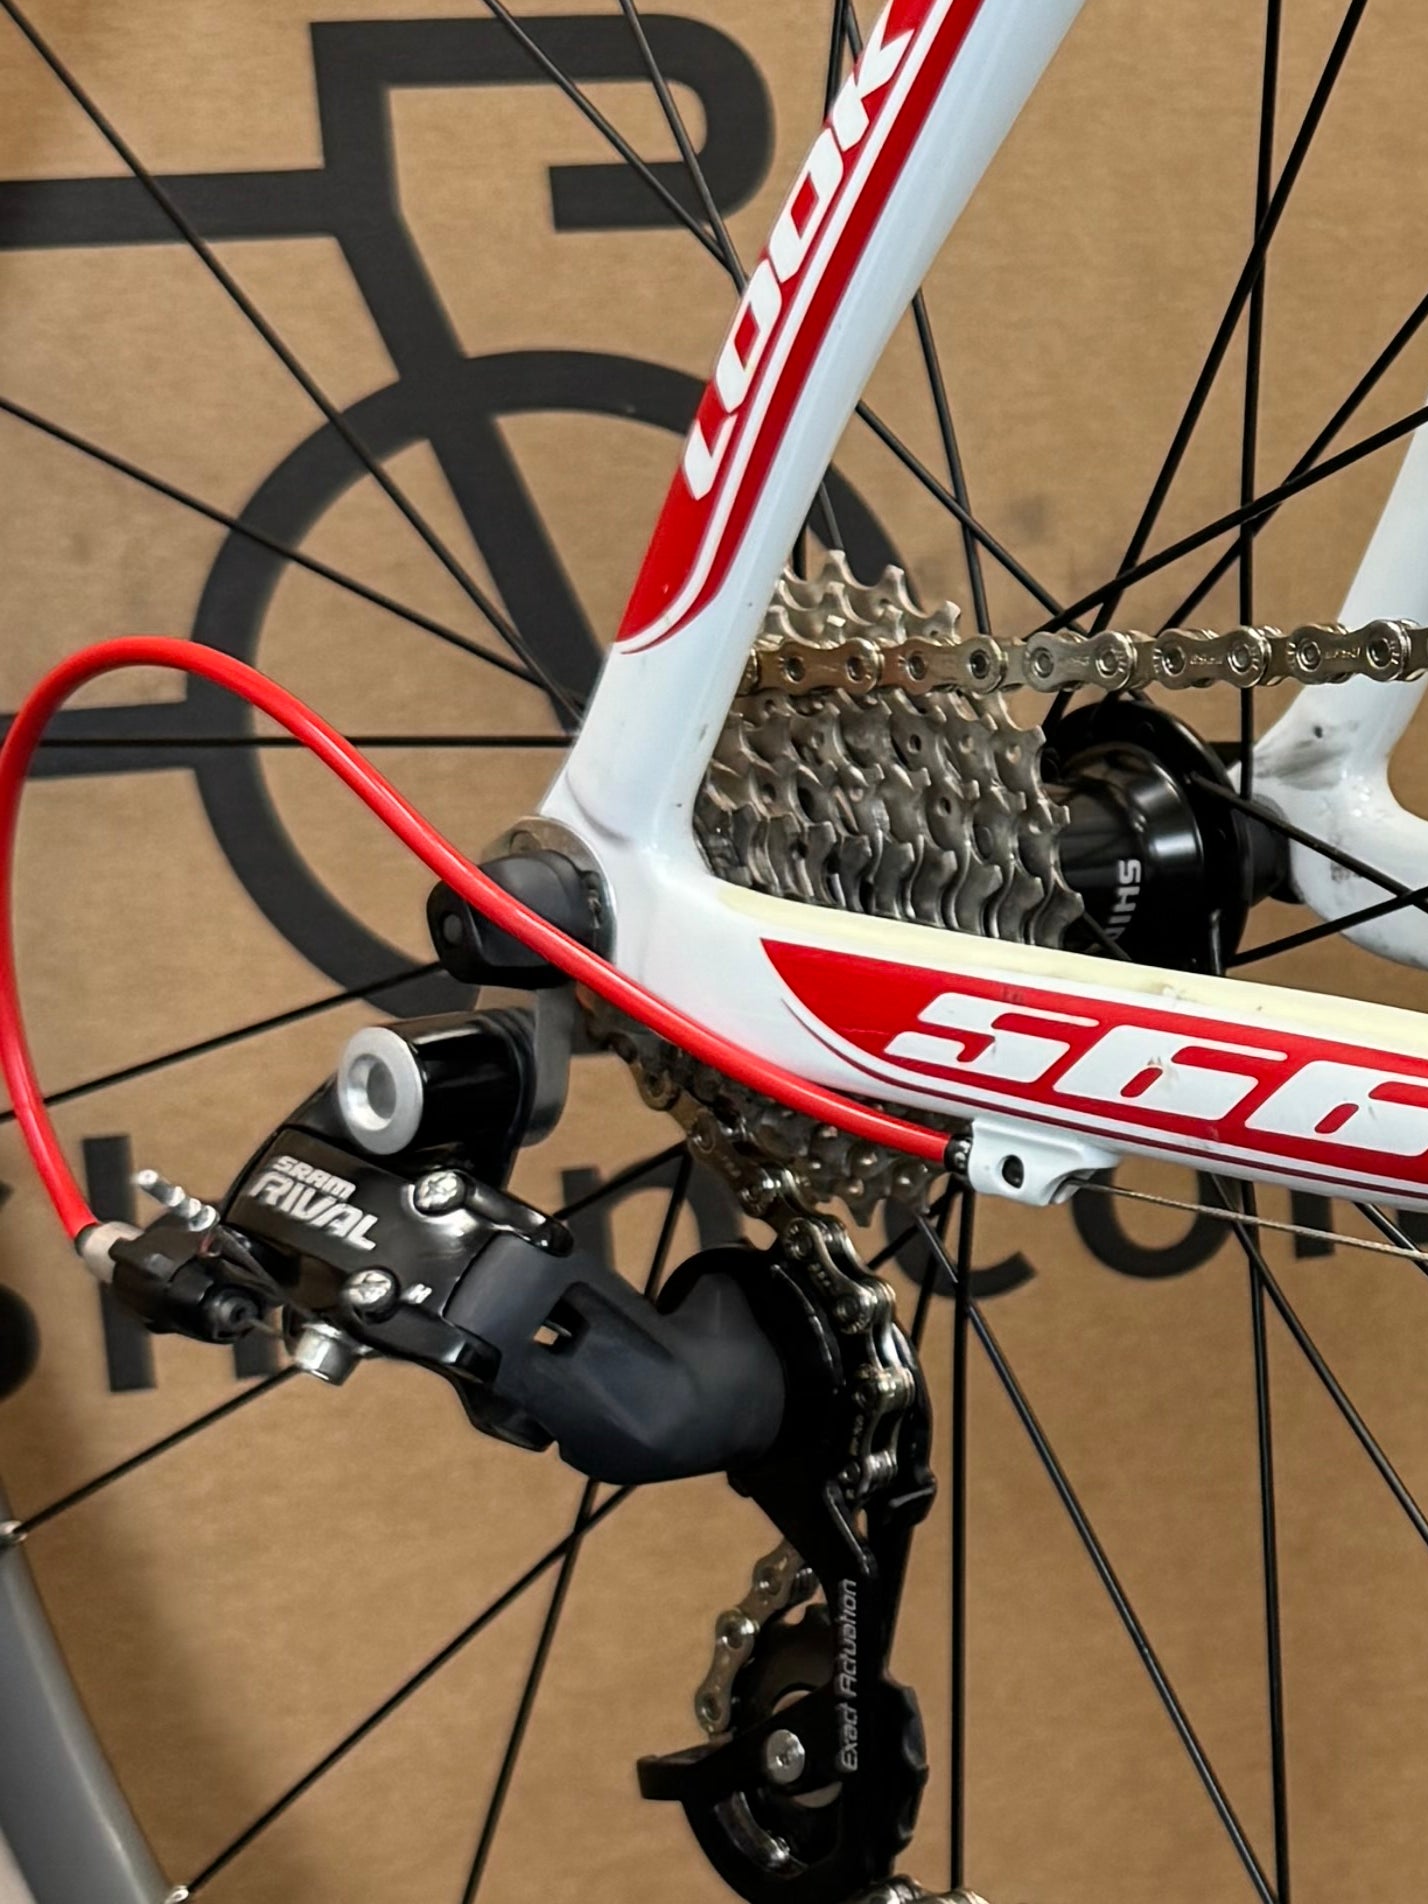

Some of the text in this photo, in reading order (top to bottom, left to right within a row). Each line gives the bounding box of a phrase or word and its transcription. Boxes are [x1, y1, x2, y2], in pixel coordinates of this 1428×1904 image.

[250, 1170, 379, 1252] RIVAL
[273, 1154, 357, 1202] SRAM
[837, 1578, 859, 1772] Exact Actuation
